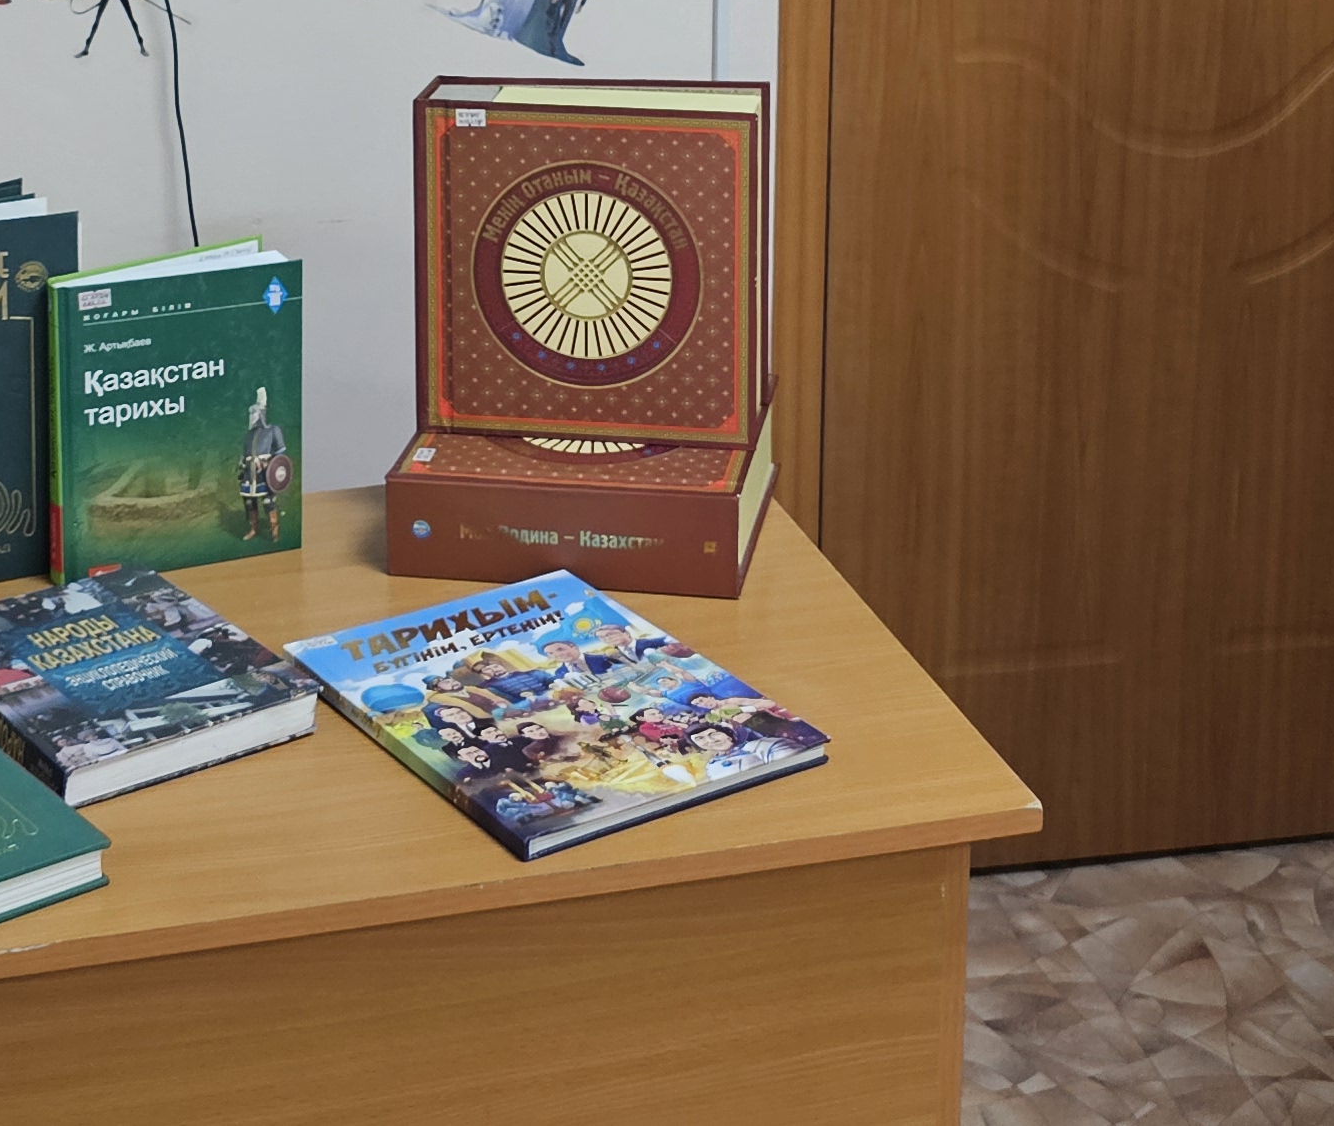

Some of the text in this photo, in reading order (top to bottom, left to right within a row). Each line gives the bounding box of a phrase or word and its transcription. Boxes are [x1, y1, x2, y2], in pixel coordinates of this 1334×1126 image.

[481, 193, 526, 245] Менің
[520, 167, 592, 199] Отаным
[613, 172, 689, 251] Қазақстан
[83, 358, 226, 397] Қазақстан
[83, 395, 186, 428] тарихы
[27, 614, 120, 650] НАРОДЫ
[339, 588, 558, 662] ТАРИХЫМ-
[27, 624, 163, 673] КАЗАХСТАНА
